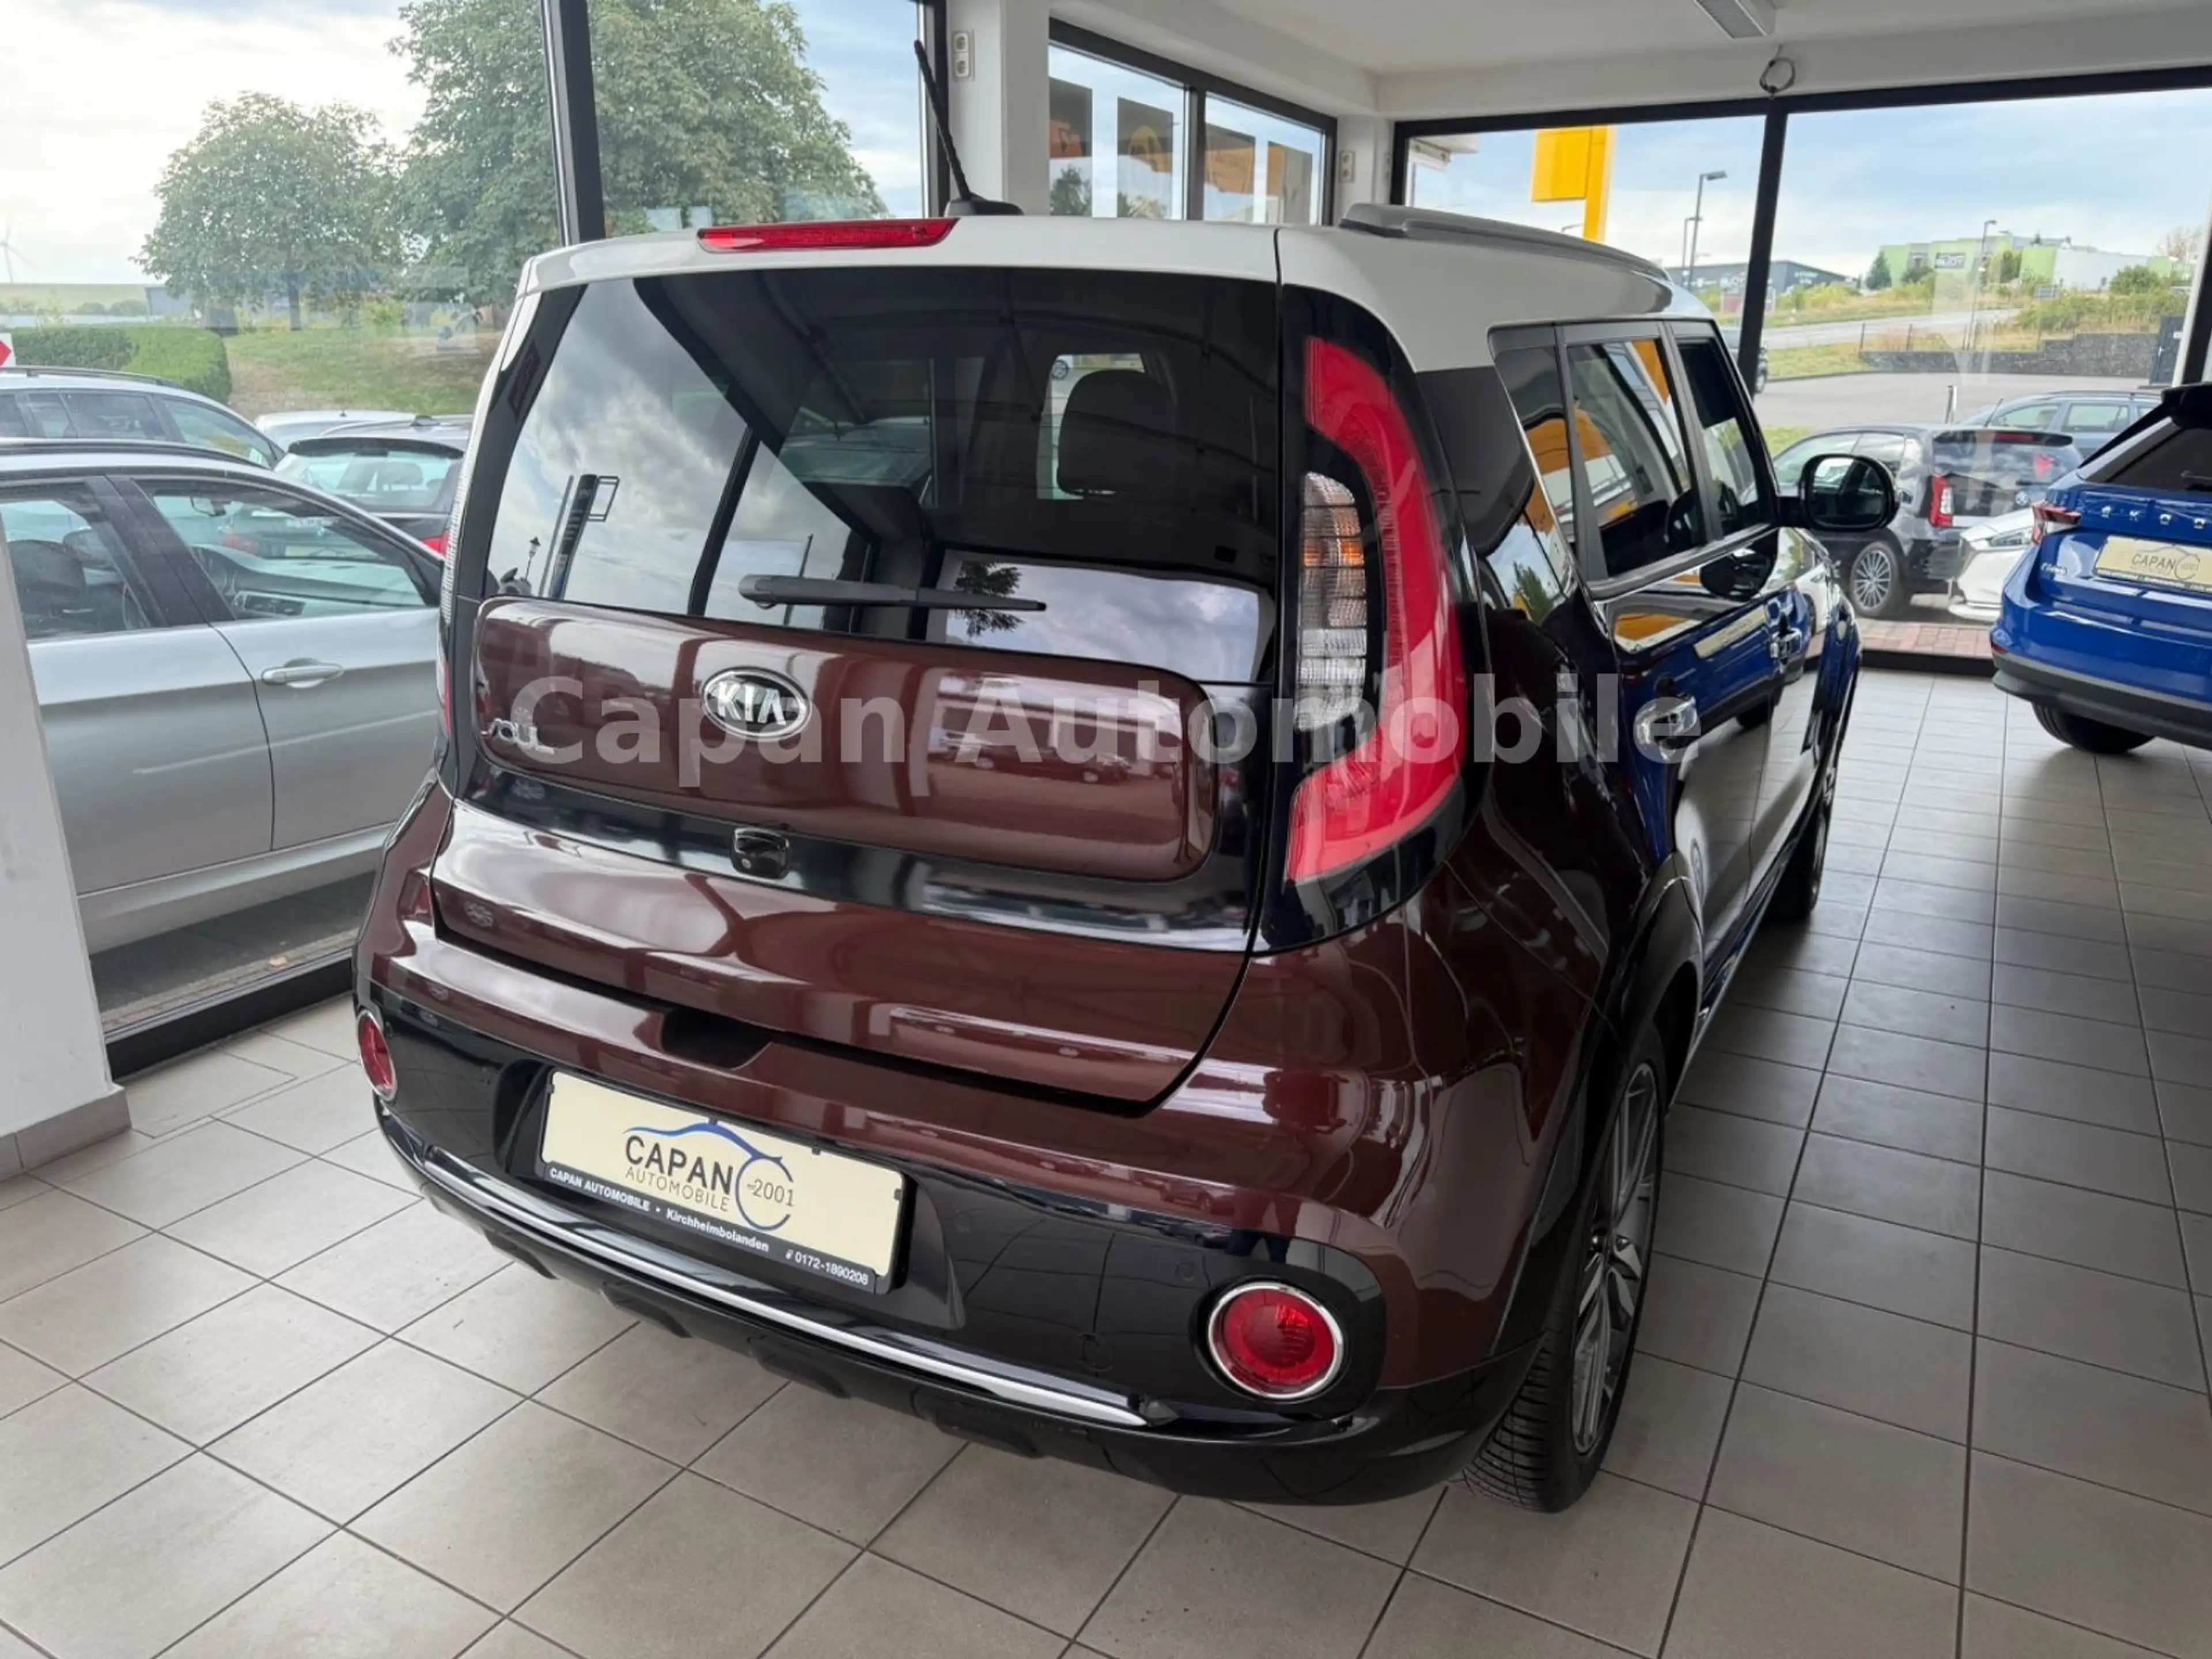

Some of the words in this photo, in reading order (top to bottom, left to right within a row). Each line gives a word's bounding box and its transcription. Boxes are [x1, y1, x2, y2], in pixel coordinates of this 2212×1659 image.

[2132, 552, 2176, 570] CAPAN
[717, 681, 786, 726] KIA
[626, 1135, 733, 1195] CAPAN
[550, 1167, 583, 1188] CAPAN
[584, 1180, 651, 1211] AUTOMOBILE
[666, 1207, 770, 1252] Kirchheimbolanden
[625, 1166, 730, 1212] AUTOMOBILE
